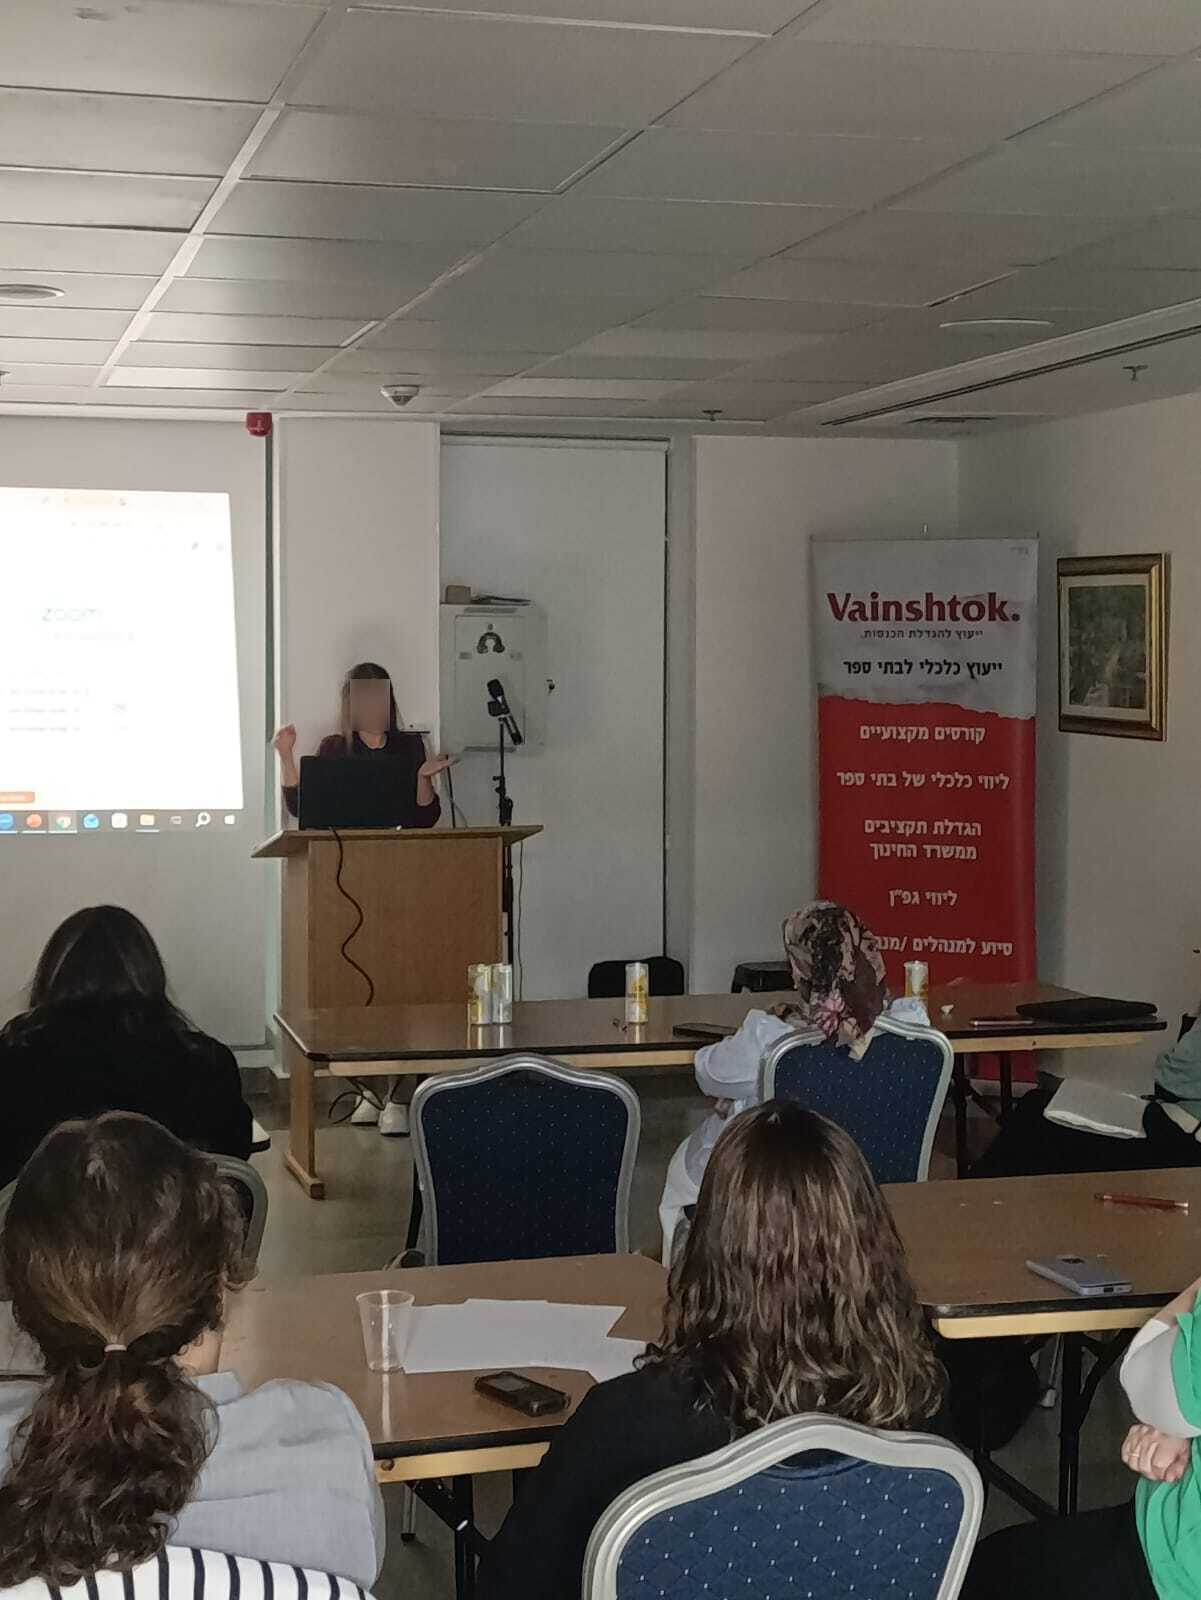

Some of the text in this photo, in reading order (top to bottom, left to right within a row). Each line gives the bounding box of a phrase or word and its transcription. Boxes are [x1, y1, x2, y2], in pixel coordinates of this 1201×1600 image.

[827, 592, 1020, 621] Vainshtok.
[843, 659, 1002, 678] ייעוץ כלכלי לבתי ספר
[860, 725, 986, 744] קורסים מקצועיים
[836, 771, 1009, 789] ליווי כלכלי של בתי ספר
[864, 819, 982, 837] הגדלת תקציבים
[870, 843, 977, 860] ממשרד החינוך
[925, 890, 958, 906] ליווי
[912, 936, 976, 954] למנהלים
[980, 941, 1013, 956] סיוע
